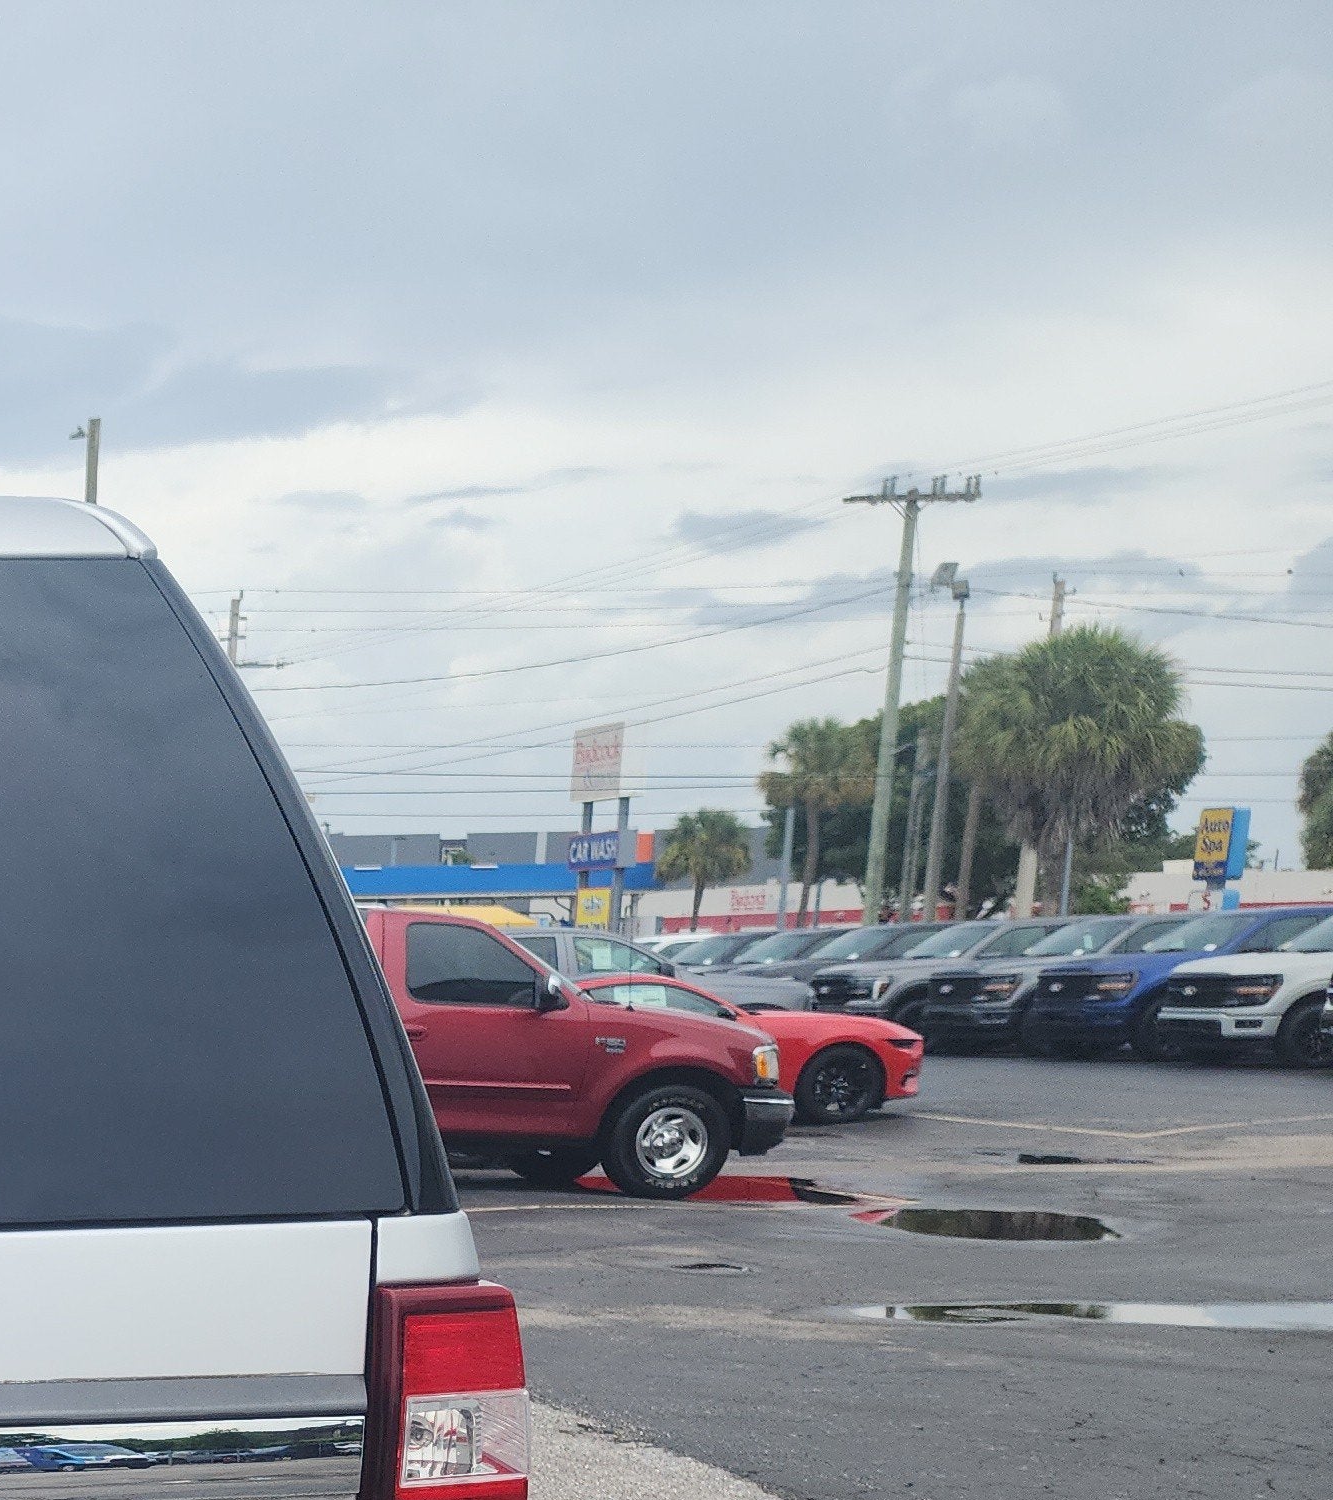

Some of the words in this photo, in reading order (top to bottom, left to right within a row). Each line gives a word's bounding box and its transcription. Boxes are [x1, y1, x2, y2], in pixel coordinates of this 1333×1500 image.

[1201, 817, 1230, 834] Auto
[569, 841, 590, 862] CAR
[591, 838, 618, 860] WASH
[1201, 836, 1223, 855] Spa
